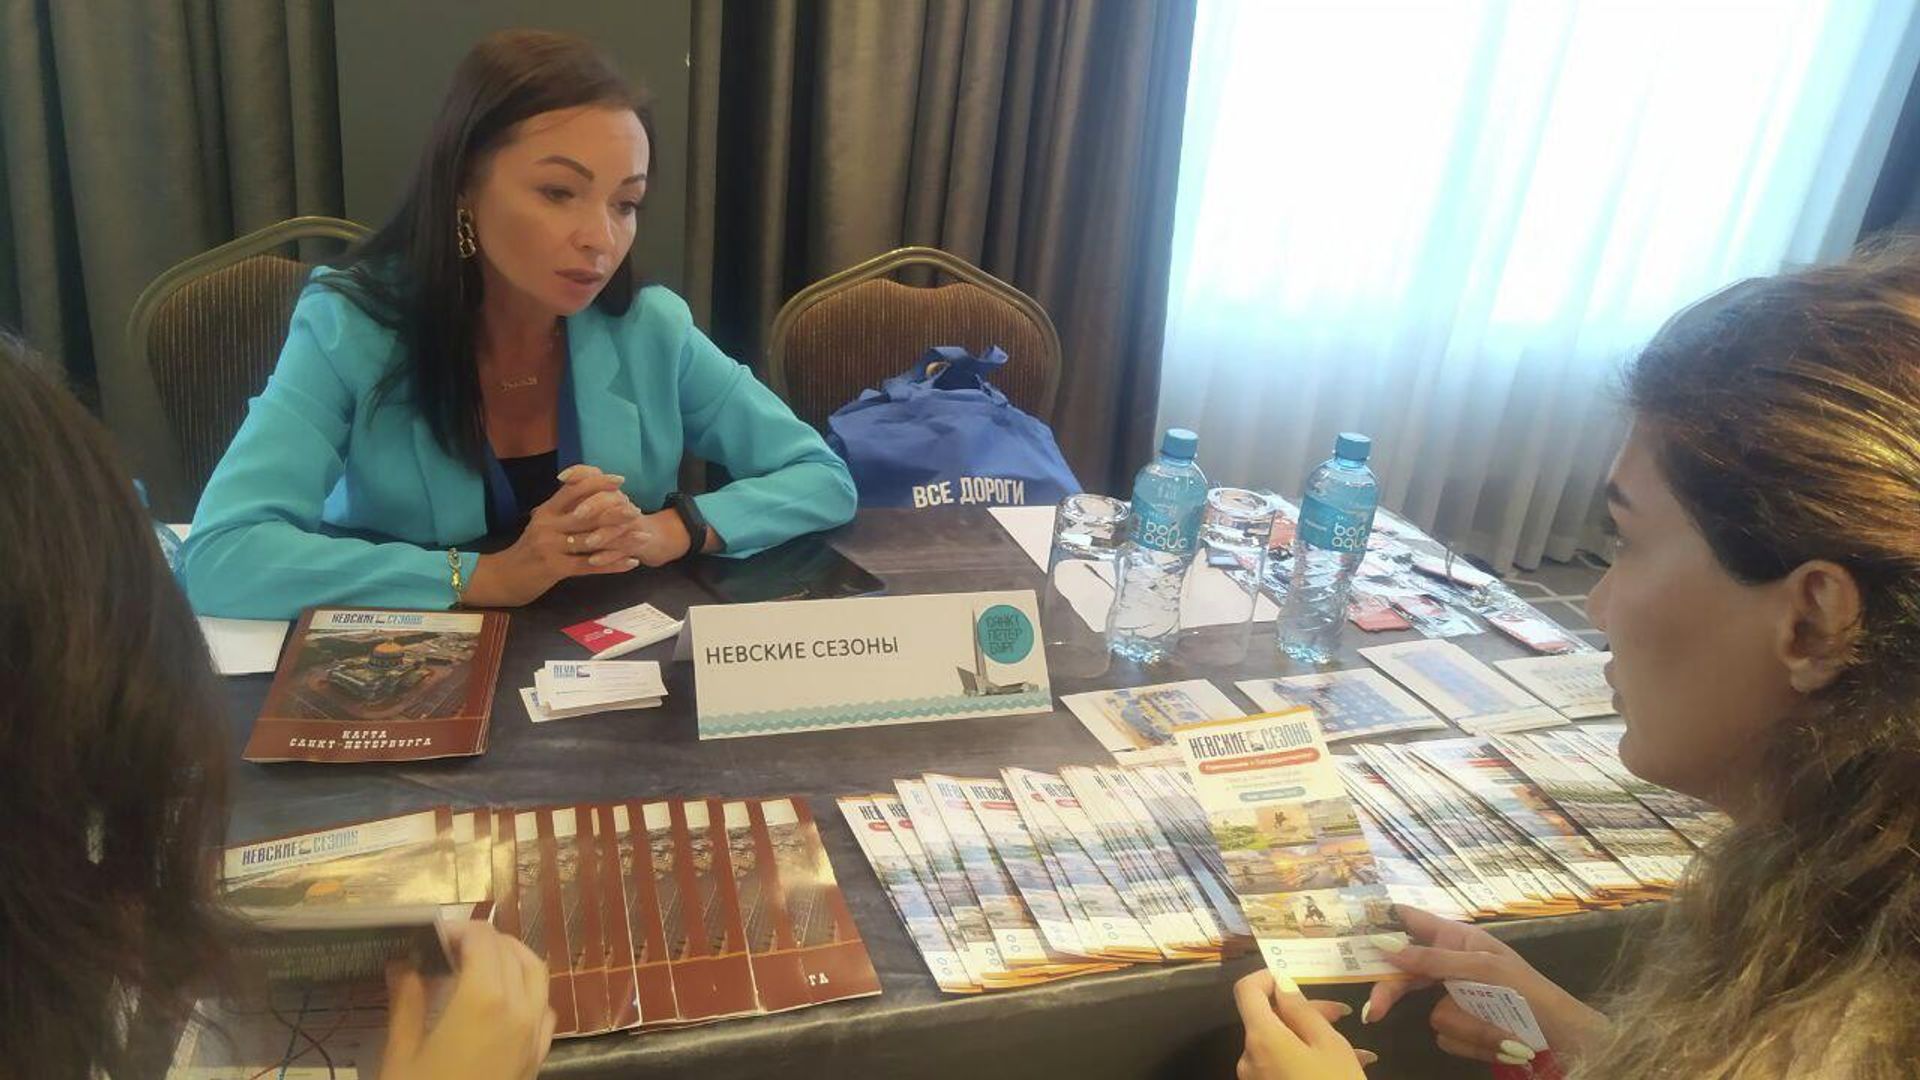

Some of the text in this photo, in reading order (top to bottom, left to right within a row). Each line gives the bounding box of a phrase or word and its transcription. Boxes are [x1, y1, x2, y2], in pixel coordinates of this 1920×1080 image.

[912, 477, 1024, 508] ВСЕ ДОРОГИ
[705, 636, 899, 665] НЕВСКИЕ СЕЗОНЫ
[342, 730, 387, 739] КАРТА
[1188, 731, 1250, 759] НЕВСКИЕ
[241, 843, 296, 866] НЕВСКИЕ
